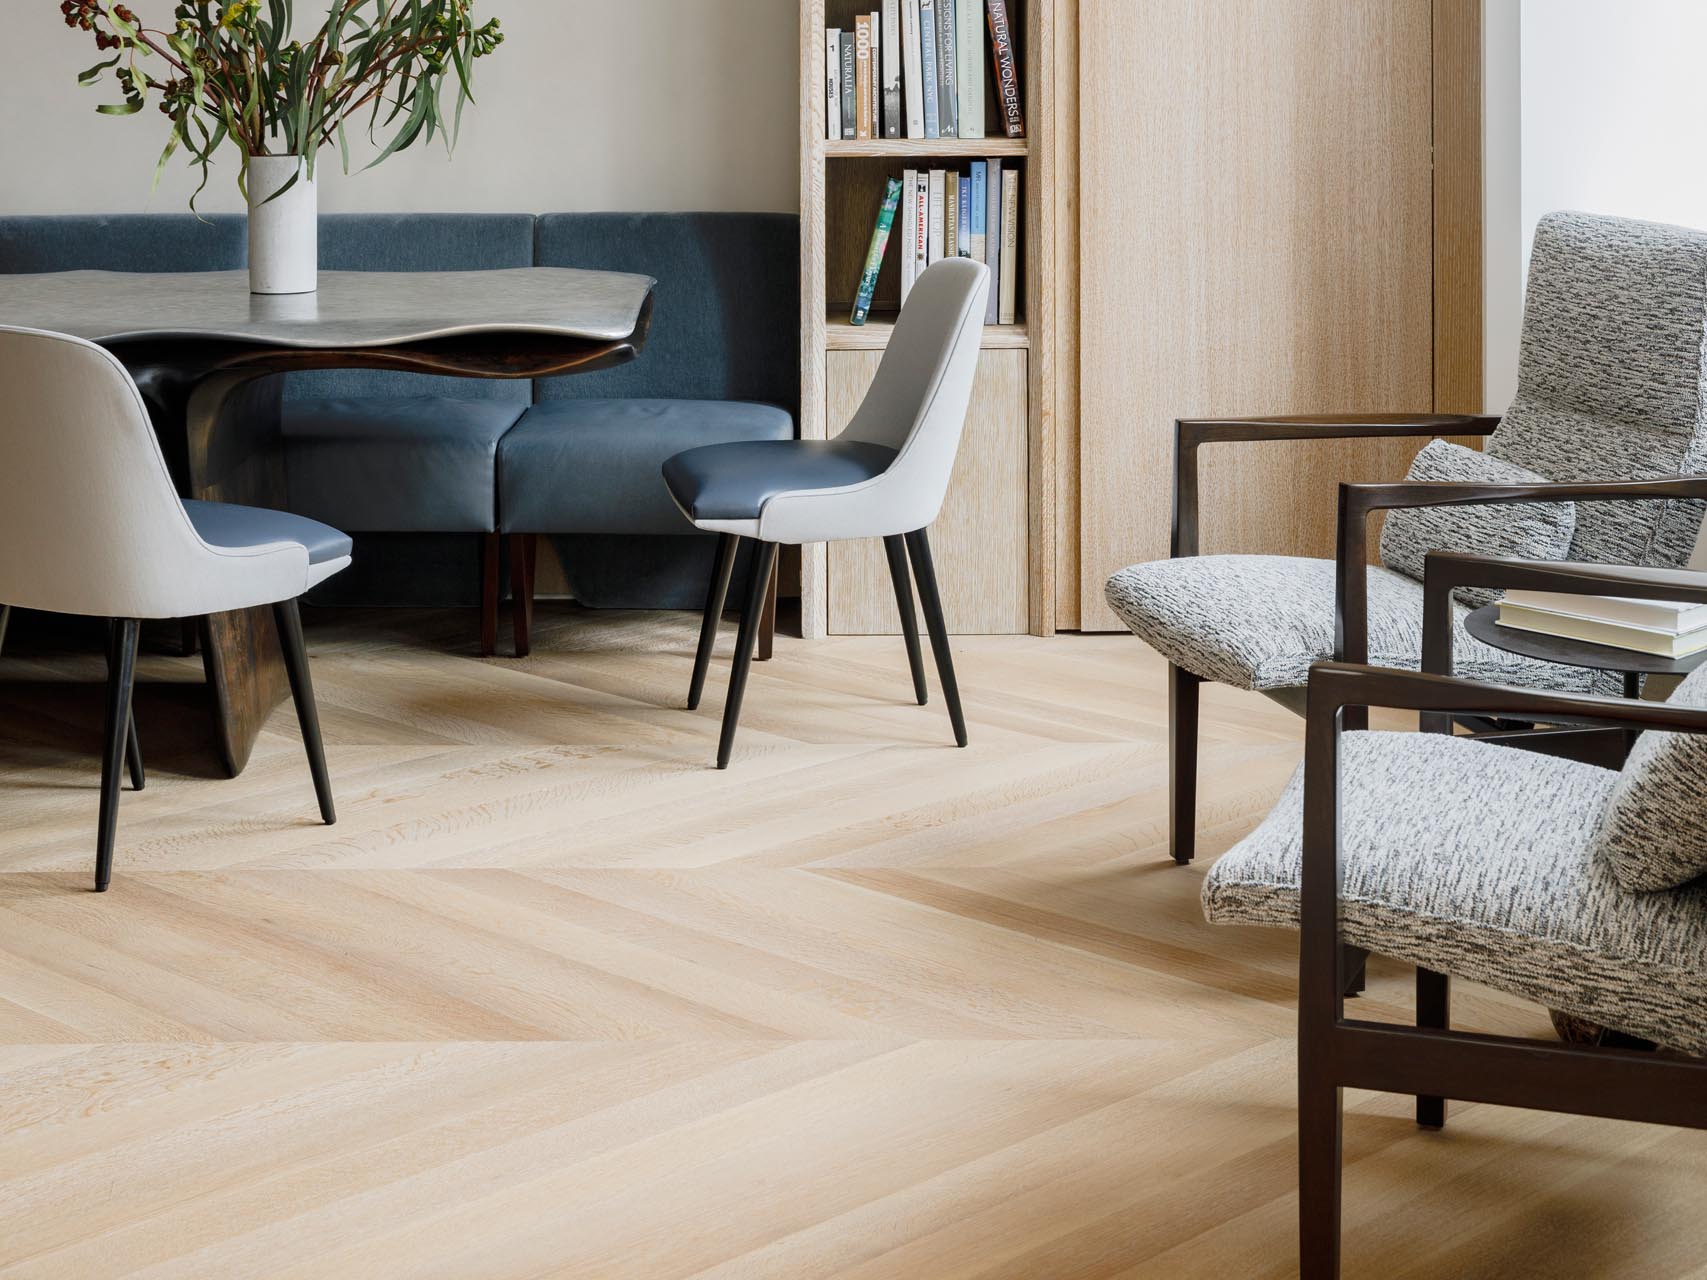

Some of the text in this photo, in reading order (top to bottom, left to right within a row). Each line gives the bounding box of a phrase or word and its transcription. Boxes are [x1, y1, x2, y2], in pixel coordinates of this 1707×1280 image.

[857, 22, 869, 59] 1000
[944, 32, 952, 52] FOR
[844, 44, 852, 93] NATURALIA
[944, 54, 953, 85] LIVING
[992, 2, 1018, 116] NATURAL WONDERS
[906, 176, 914, 189] THE
[976, 171, 981, 181] MR
[906, 190, 914, 204] NEW
[1007, 177, 1015, 247] THE NEW VISION
[905, 239, 913, 259] HOUSE
